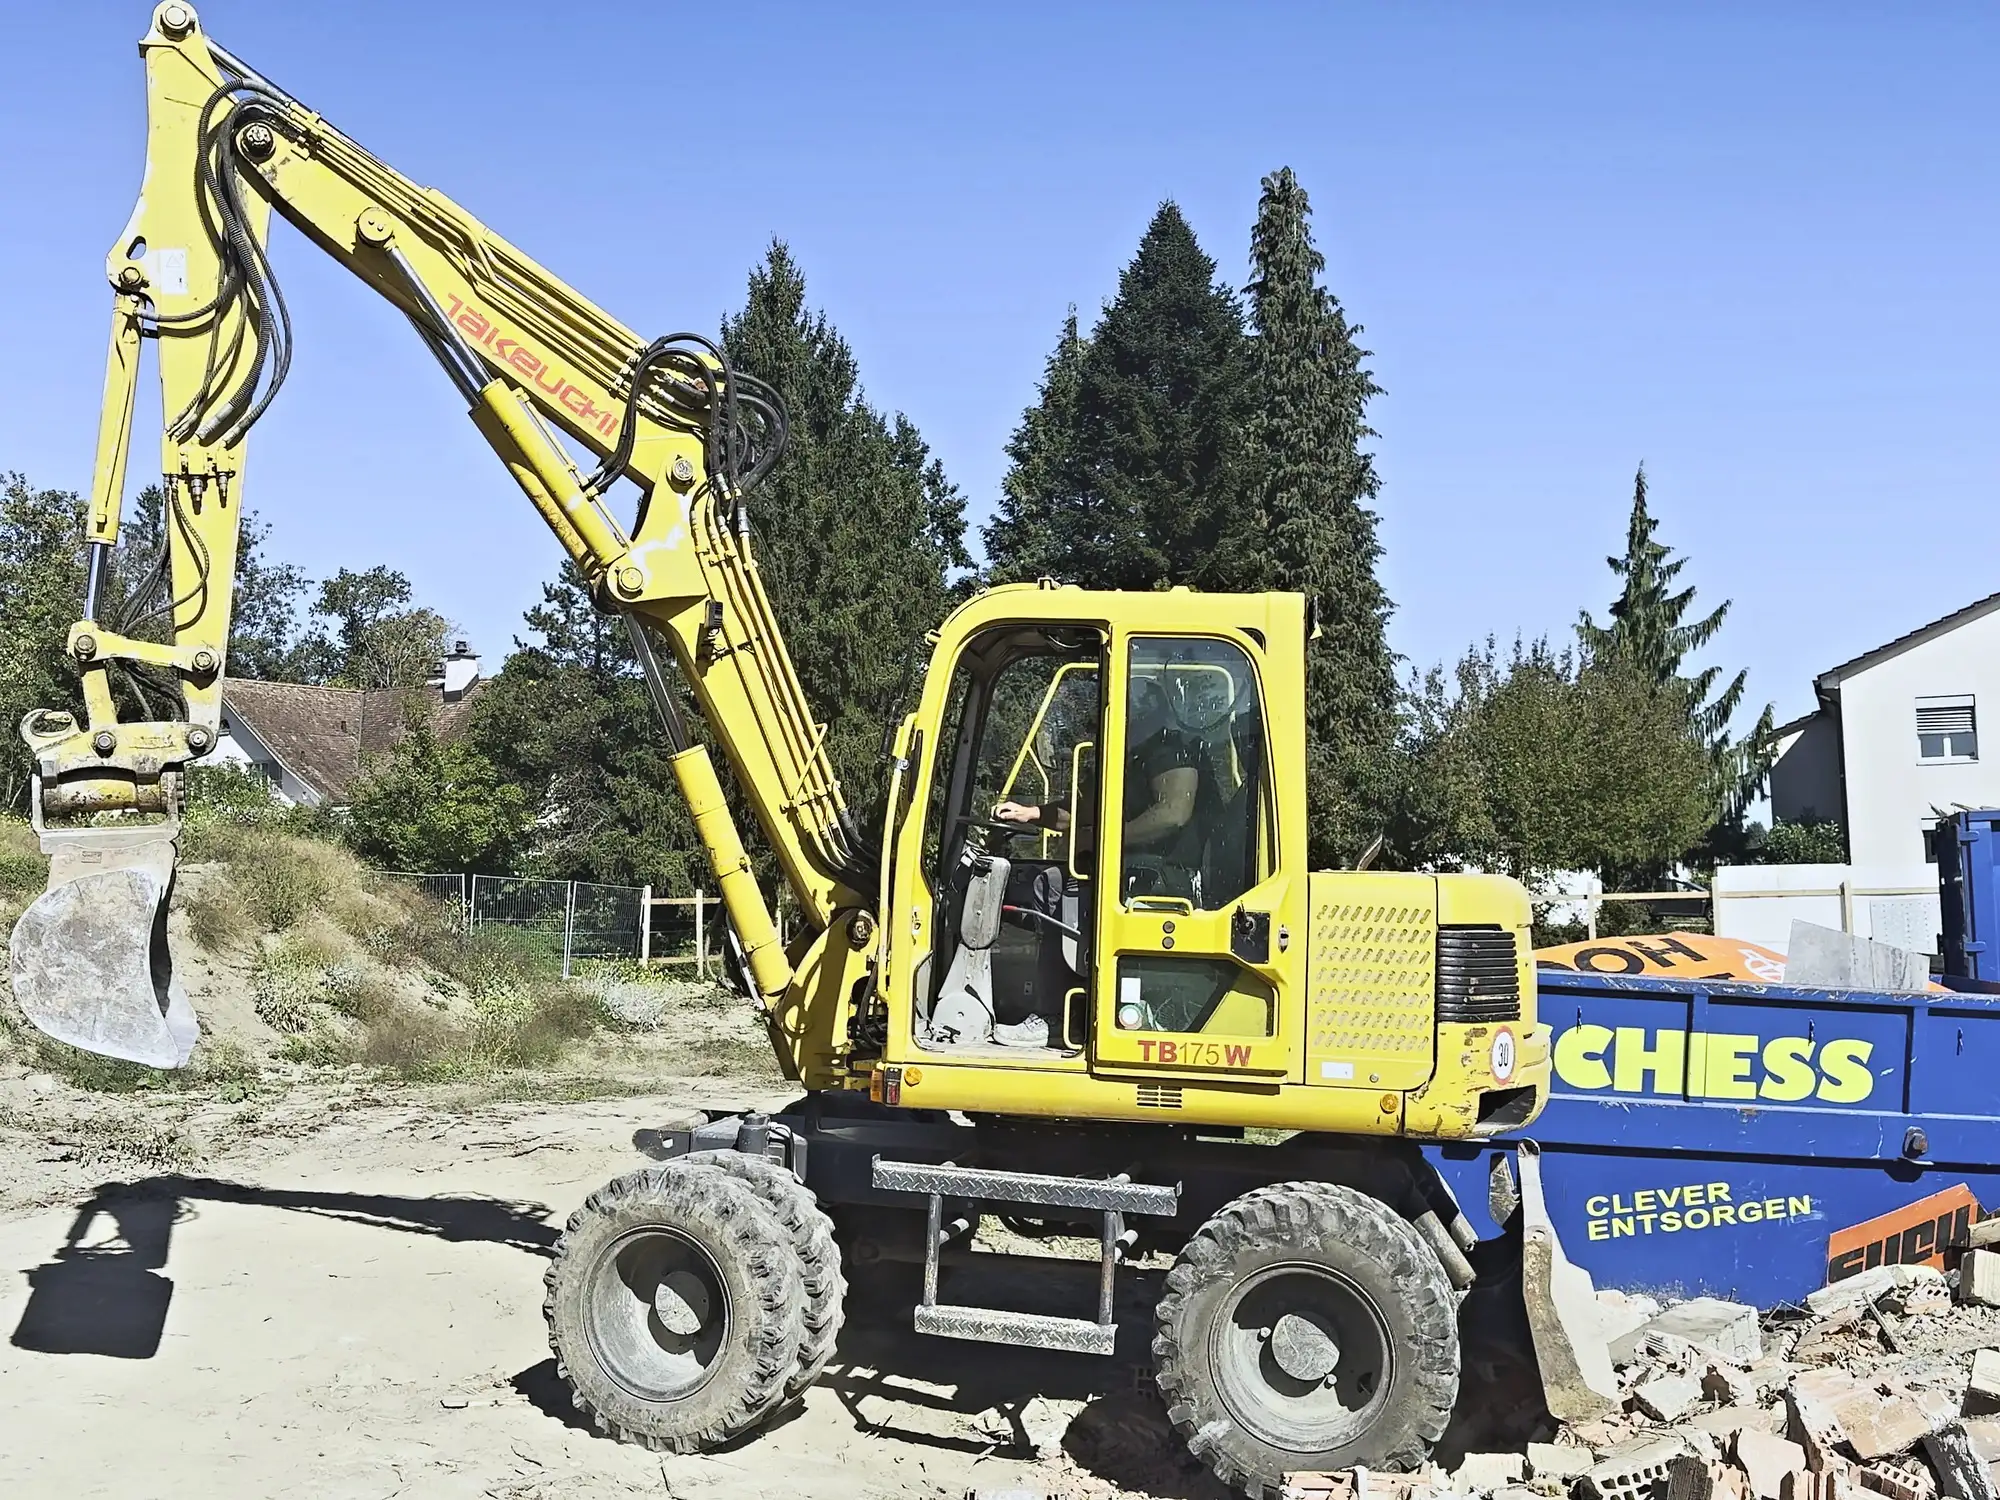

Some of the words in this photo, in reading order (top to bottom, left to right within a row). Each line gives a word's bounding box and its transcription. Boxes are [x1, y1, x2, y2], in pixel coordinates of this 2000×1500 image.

[1499, 1042, 1509, 1067] 30
[1537, 1022, 1874, 1103] CHESS
[1585, 1181, 1731, 1217] CLEVER
[1587, 1194, 1811, 1241] ENTSORGEN
